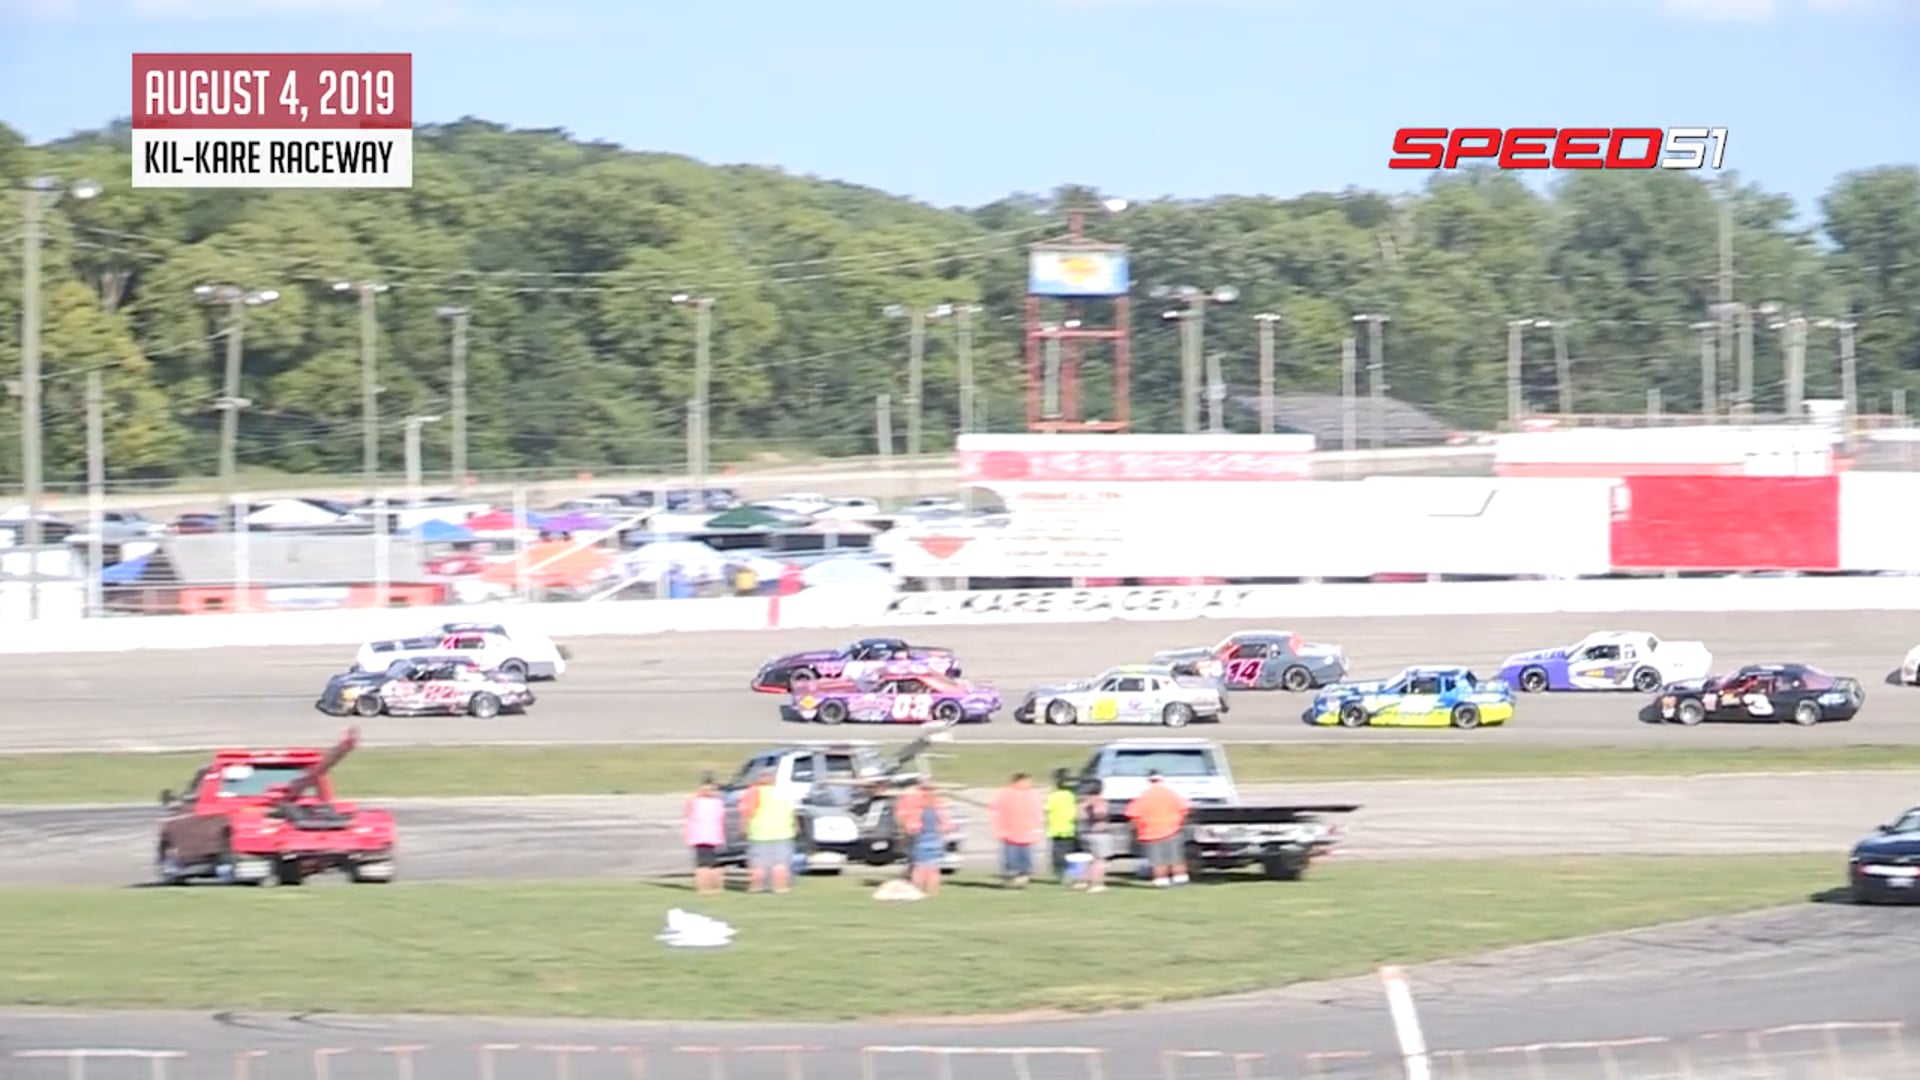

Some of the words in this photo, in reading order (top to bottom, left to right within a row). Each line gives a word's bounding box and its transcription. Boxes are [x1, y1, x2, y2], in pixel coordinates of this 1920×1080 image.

[1071, 588, 1255, 614] RACEWAY
[1227, 658, 1263, 687] 14
[1742, 693, 1774, 716] 3
